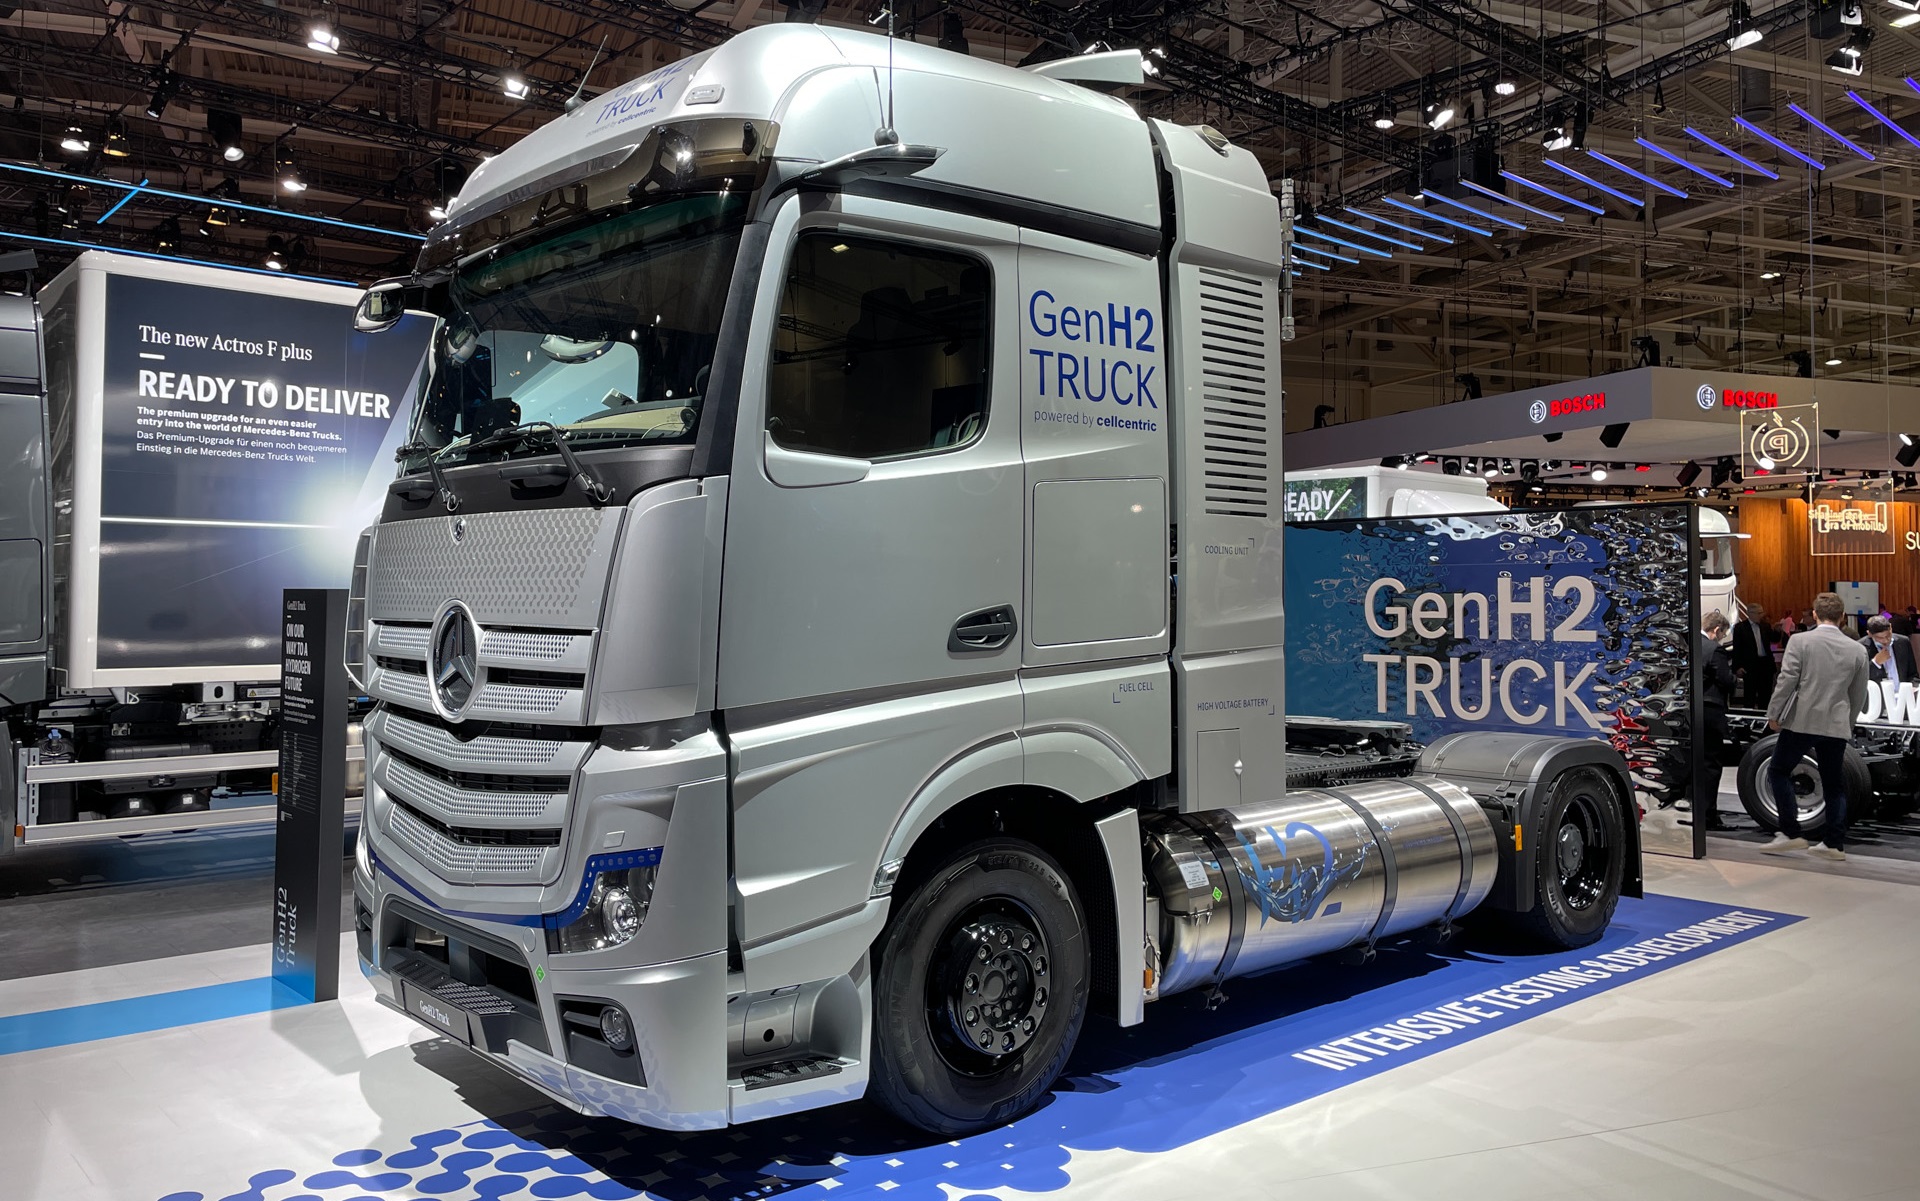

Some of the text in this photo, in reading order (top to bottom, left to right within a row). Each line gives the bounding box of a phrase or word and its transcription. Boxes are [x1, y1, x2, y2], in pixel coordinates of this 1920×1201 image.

[596, 77, 675, 124] TRUCK
[1029, 289, 1156, 353] GenH2
[139, 324, 313, 362] The new Actros F plus
[1029, 348, 1159, 409] TRUCK
[139, 369, 391, 419] READY TO DELIVER
[1550, 392, 1606, 417] BOSCH
[1723, 389, 1778, 409] BOSCH
[137, 406, 317, 429] The premium upgrade for an even easier
[1034, 410, 1157, 432] powered by cellcentric
[137, 418, 342, 441] entry into the world of Mercedes-Benz Trucks.
[136, 430, 348, 454] Das Premium-Upgrade für einen noch bequemeren
[136, 443, 317, 464] Einstieg in die Mercedes-Benz Trucks Welt.
[1284, 490, 1334, 512] EADY
[1205, 545, 1249, 556] COOLING UNIT
[1364, 575, 1598, 643] GenH2
[297, 641, 304, 657] TO
[304, 641, 309, 657] A
[285, 658, 311, 675] HYDROGEN
[284, 675, 303, 692] FUTURE
[1119, 681, 1154, 693] FUEL CELL
[1363, 653, 1615, 736] TRUCK
[1197, 697, 1269, 711] HIGH VOLTAGE BATTERY
[276, 886, 288, 963] GenH2
[285, 903, 298, 968] Truck
[1291, 910, 1776, 1071] INTENSIVE TESTING & DEVELOPMENT
